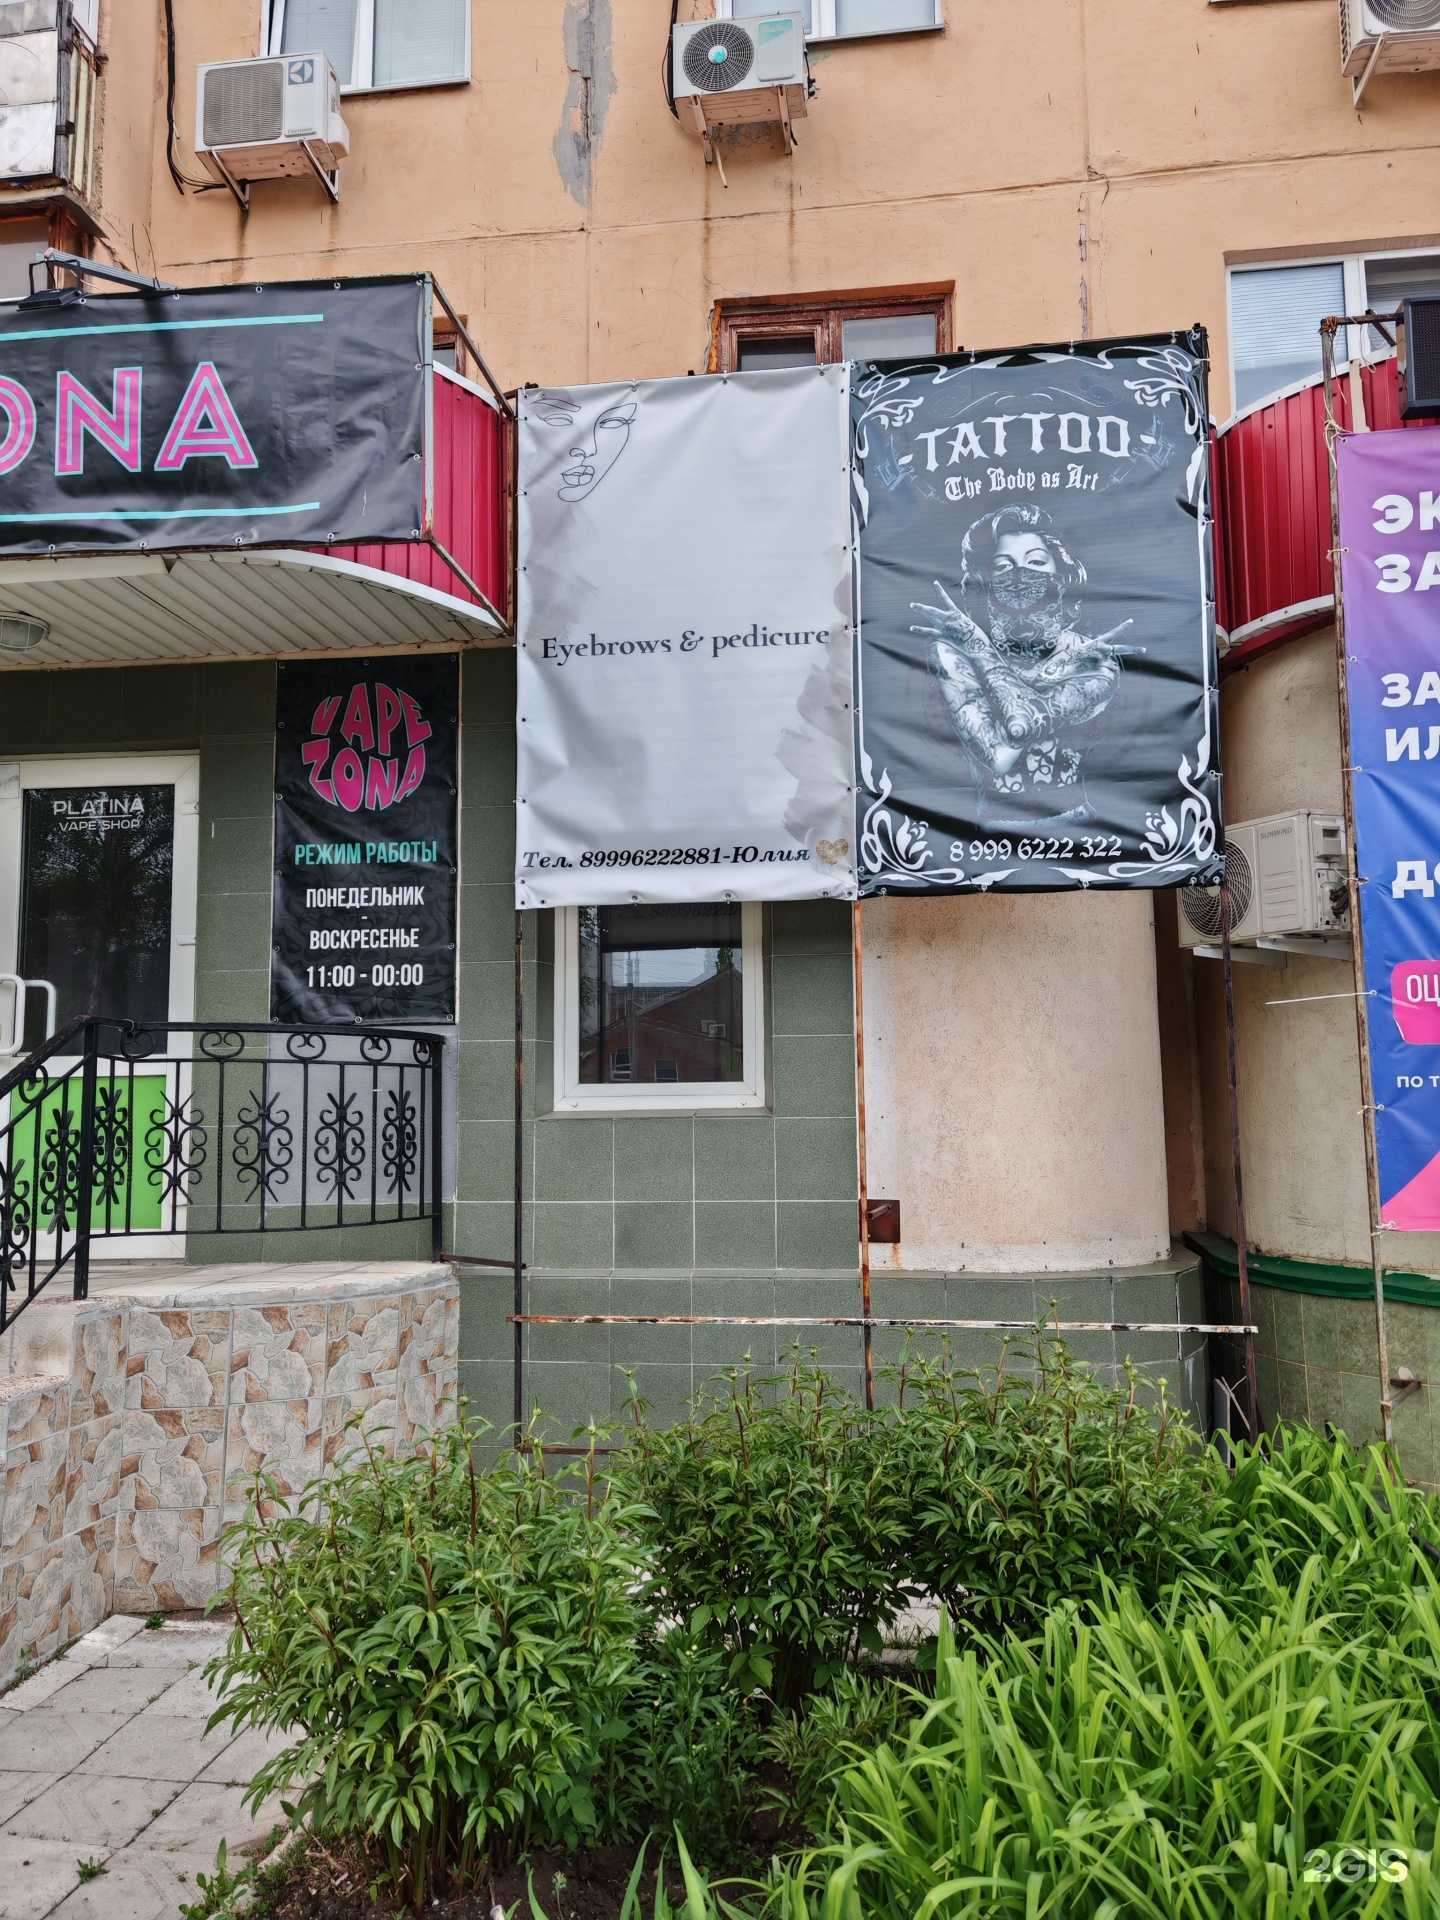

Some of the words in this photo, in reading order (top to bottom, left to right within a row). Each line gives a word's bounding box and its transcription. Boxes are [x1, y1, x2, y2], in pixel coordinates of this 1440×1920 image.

[915, 411, 1131, 472] TATTOO
[945, 476, 982, 500] The
[987, 467, 1036, 491] Body
[1041, 471, 1060, 488] as
[1065, 463, 1099, 490] Art
[540, 634, 672, 665] Eyebrows
[679, 630, 704, 652] &
[712, 624, 830, 657] pedicure
[1381, 672, 1440, 707] ЗА
[310, 682, 432, 756] VAPE
[301, 738, 426, 812] ZONA
[53, 798, 145, 815] PLATINA
[58, 821, 97, 832] VAPE
[102, 819, 140, 830] SHOP
[294, 842, 361, 865] РЕЖИМ
[366, 840, 437, 864] РАБОТЫ
[523, 851, 573, 868] Тел.
[580, 846, 810, 867] 89996222881-Юлия
[950, 841, 964, 862] 8
[969, 839, 1012, 861] 999
[1017, 837, 1074, 860] 6222
[1080, 835, 1122, 858] 322
[1391, 860, 1440, 899] Д
[306, 886, 425, 909] ПОНЕДЕЛЬНИК
[309, 928, 420, 950] ВОСКРЕСЕНЬЕ
[306, 965, 355, 988] 11:00
[371, 963, 424, 986] 00:00
[1397, 1076, 1424, 1088] по
